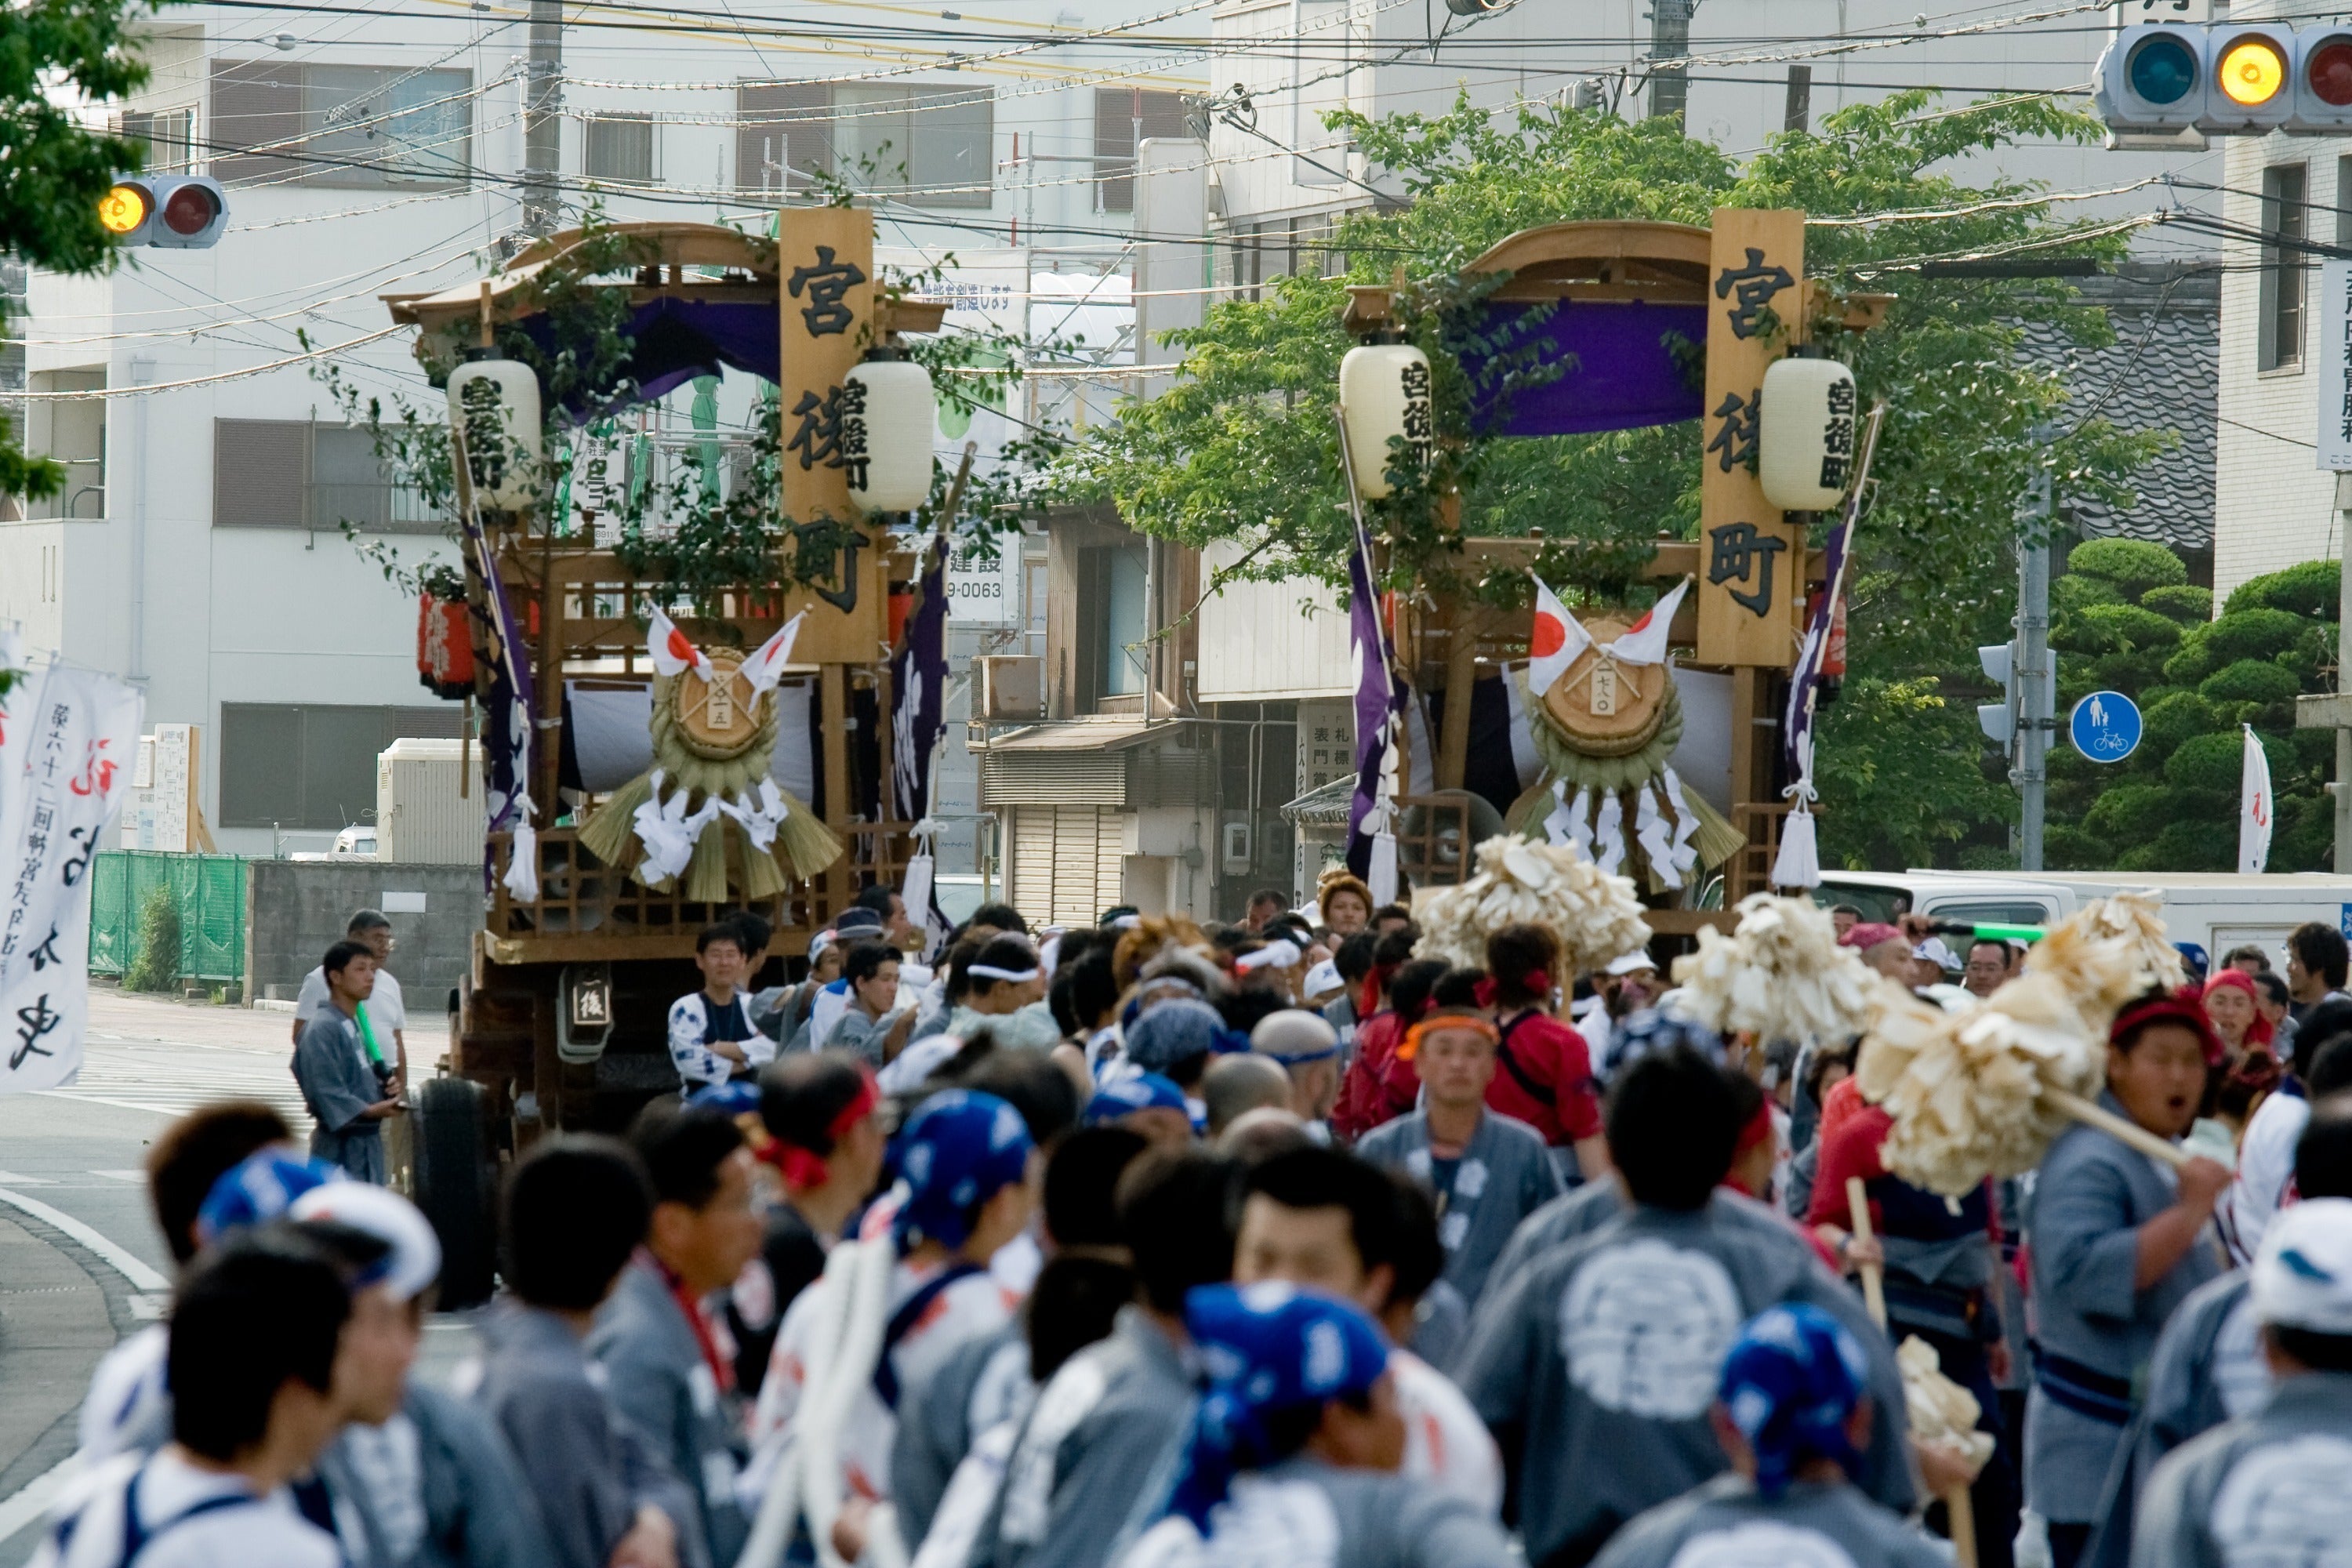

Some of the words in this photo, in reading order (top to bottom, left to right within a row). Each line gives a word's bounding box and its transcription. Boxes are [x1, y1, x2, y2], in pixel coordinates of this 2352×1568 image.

[786, 245, 870, 614] 宮後町
[843, 377, 872, 492] 宮後町
[1707, 247, 1795, 619] 宮後町
[1820, 377, 1855, 491] 宮後町
[949, 550, 1002, 573] 建設
[1313, 750, 1349, 765] 門標
[1314, 728, 1349, 742] 表札
